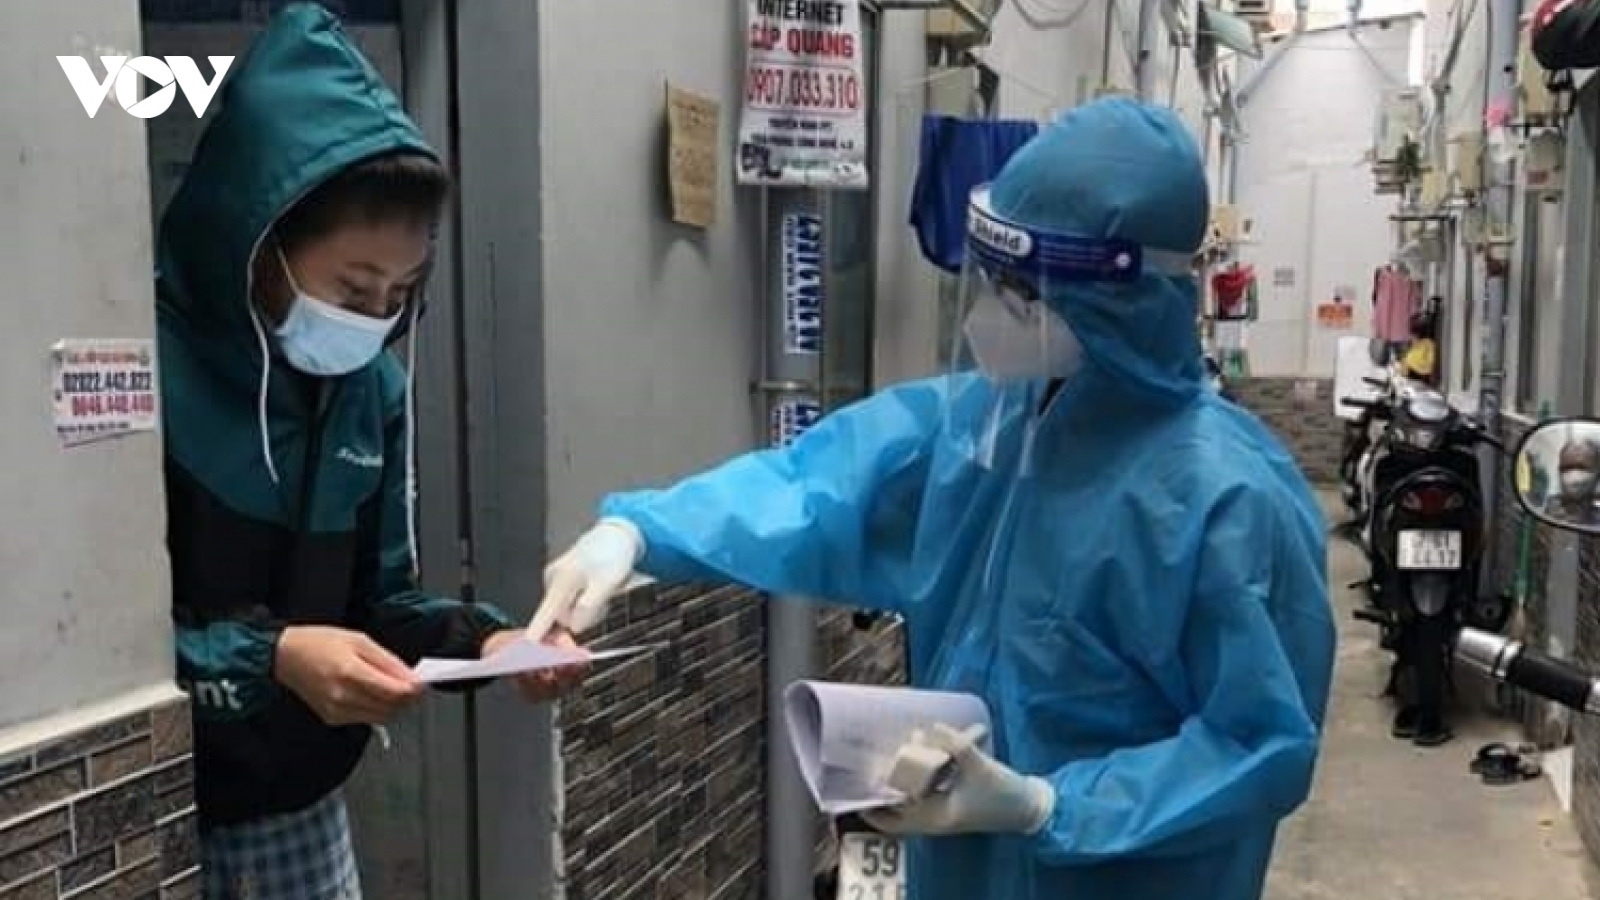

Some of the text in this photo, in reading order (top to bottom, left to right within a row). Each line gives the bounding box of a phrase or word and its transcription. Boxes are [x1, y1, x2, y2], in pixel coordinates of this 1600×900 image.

[757, 0, 843, 25] INTERNET
[787, 28, 854, 59] QUANG
[862, 837, 899, 878] 59
